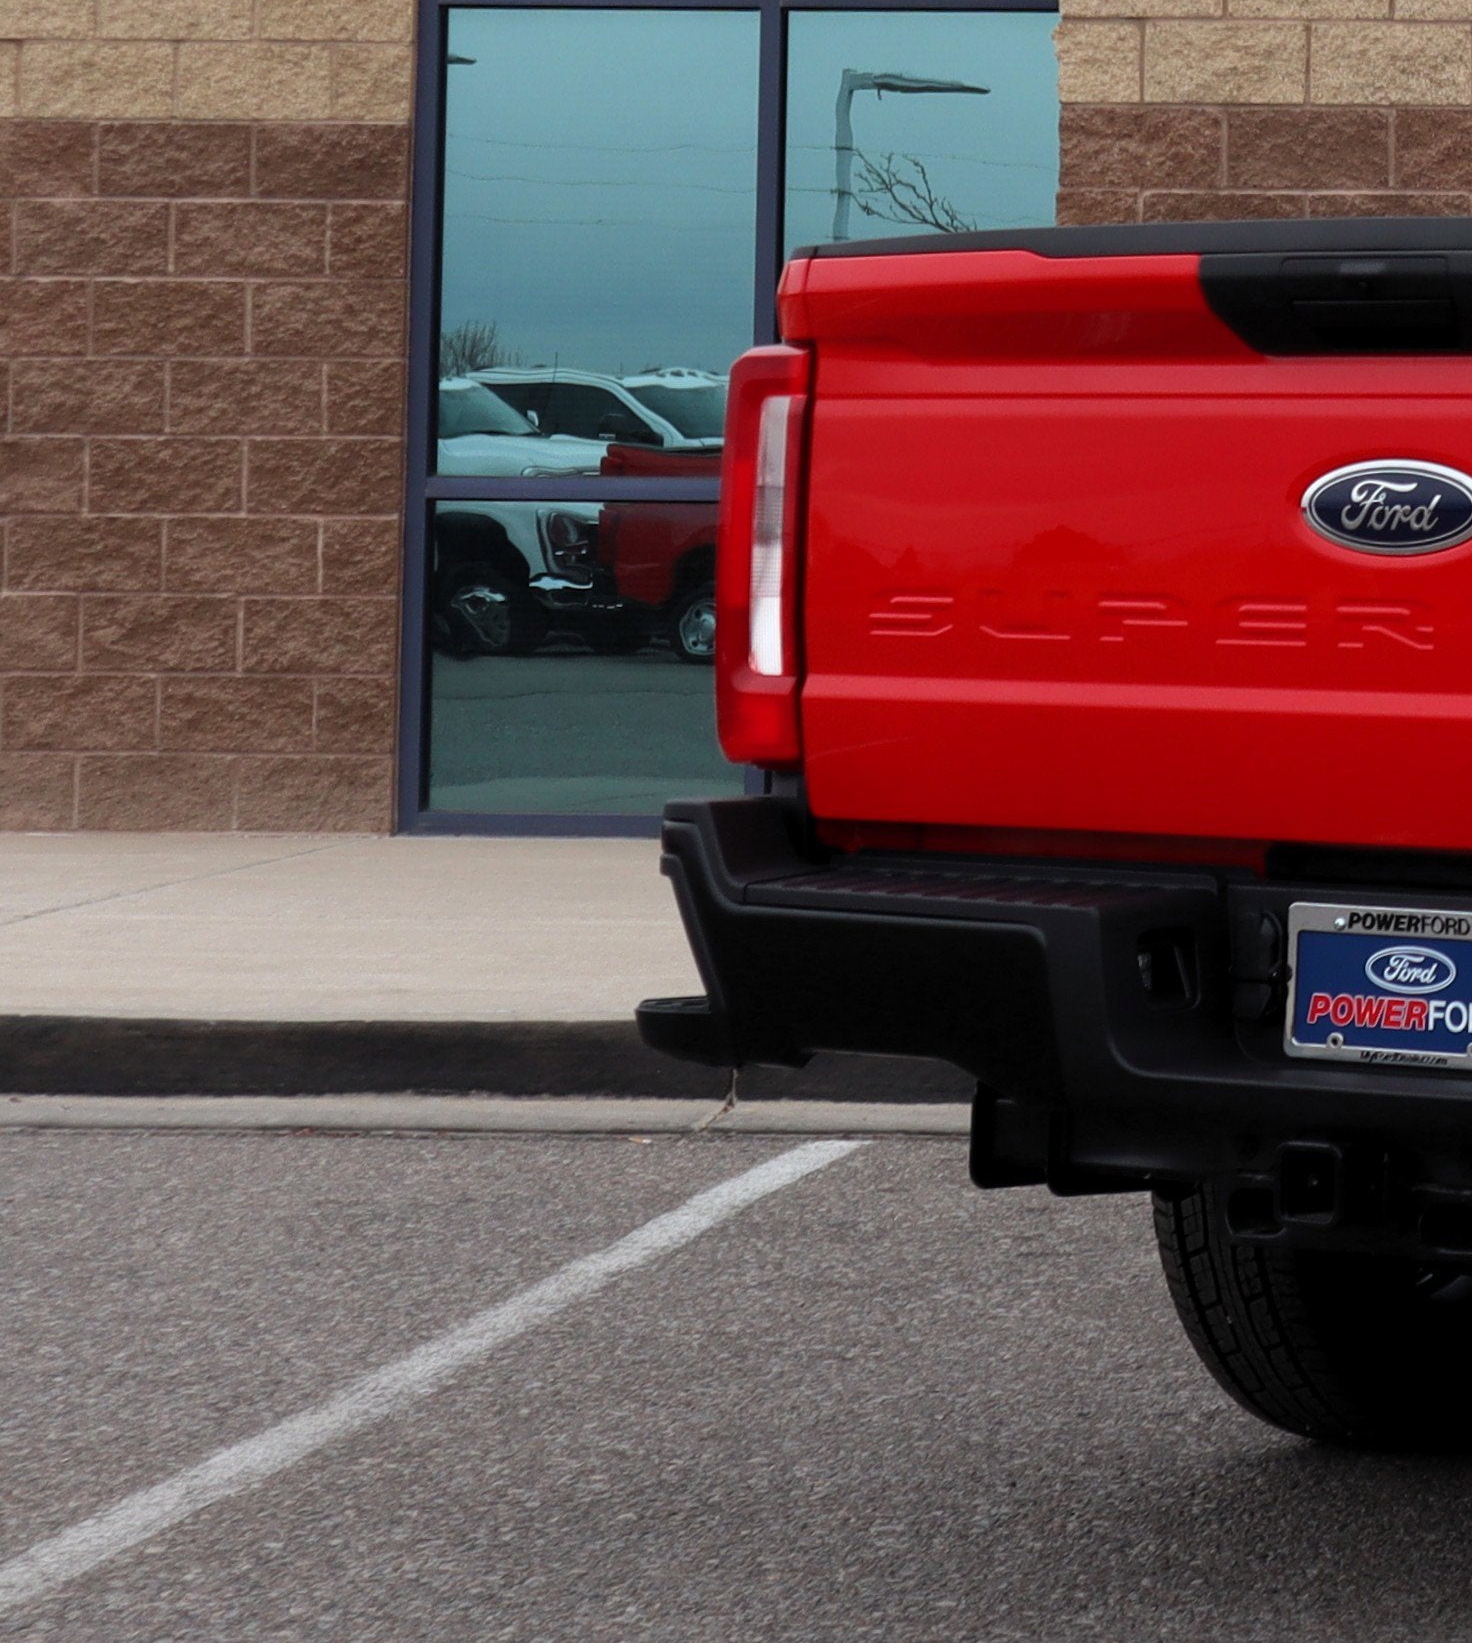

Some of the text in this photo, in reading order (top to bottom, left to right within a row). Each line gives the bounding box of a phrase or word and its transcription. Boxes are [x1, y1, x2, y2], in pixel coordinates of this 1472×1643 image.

[1341, 480, 1441, 531] Ford
[868, 590, 1434, 652] SUPER
[1347, 912, 1470, 937] POWERFORD
[1383, 954, 1437, 985] Ford
